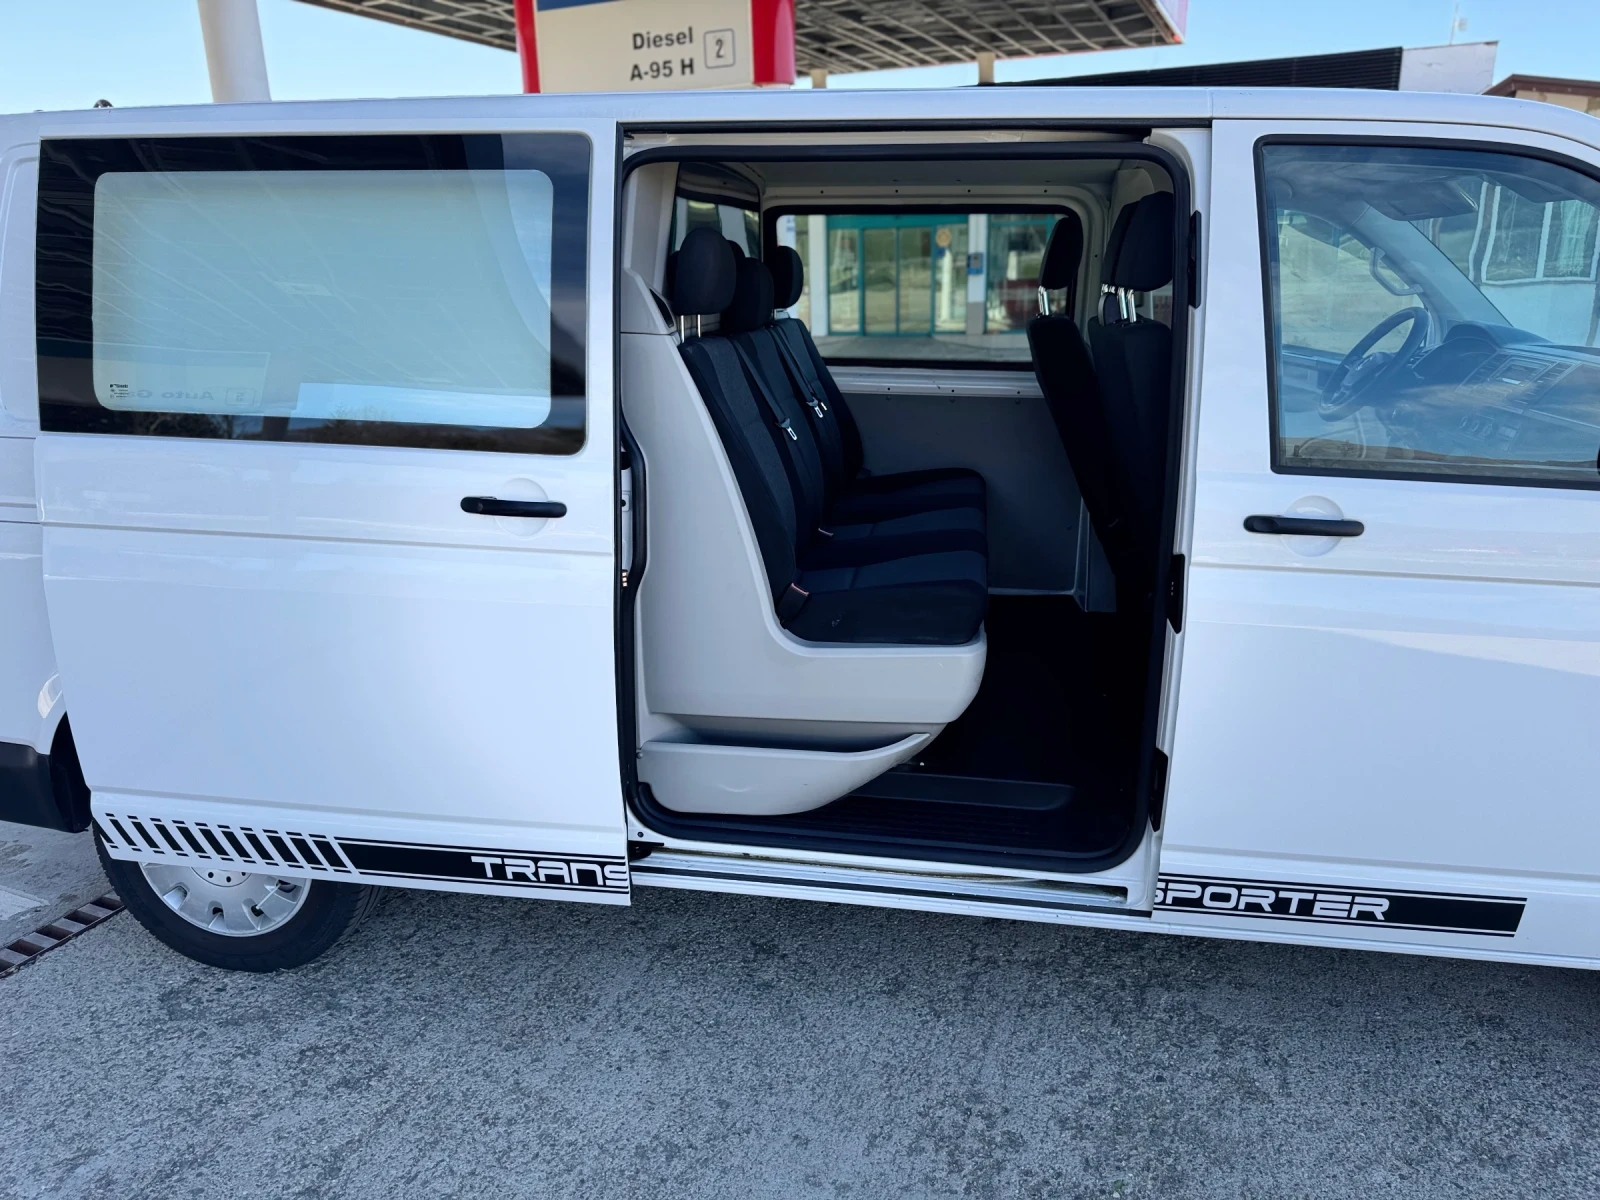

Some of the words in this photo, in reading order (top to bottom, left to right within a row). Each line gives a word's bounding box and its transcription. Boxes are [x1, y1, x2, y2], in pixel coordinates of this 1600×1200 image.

[632, 26, 694, 50] Diesel
[714, 38, 725, 59] 2
[629, 60, 674, 81] A-95
[680, 57, 695, 76] H
[470, 855, 629, 887] TRANS
